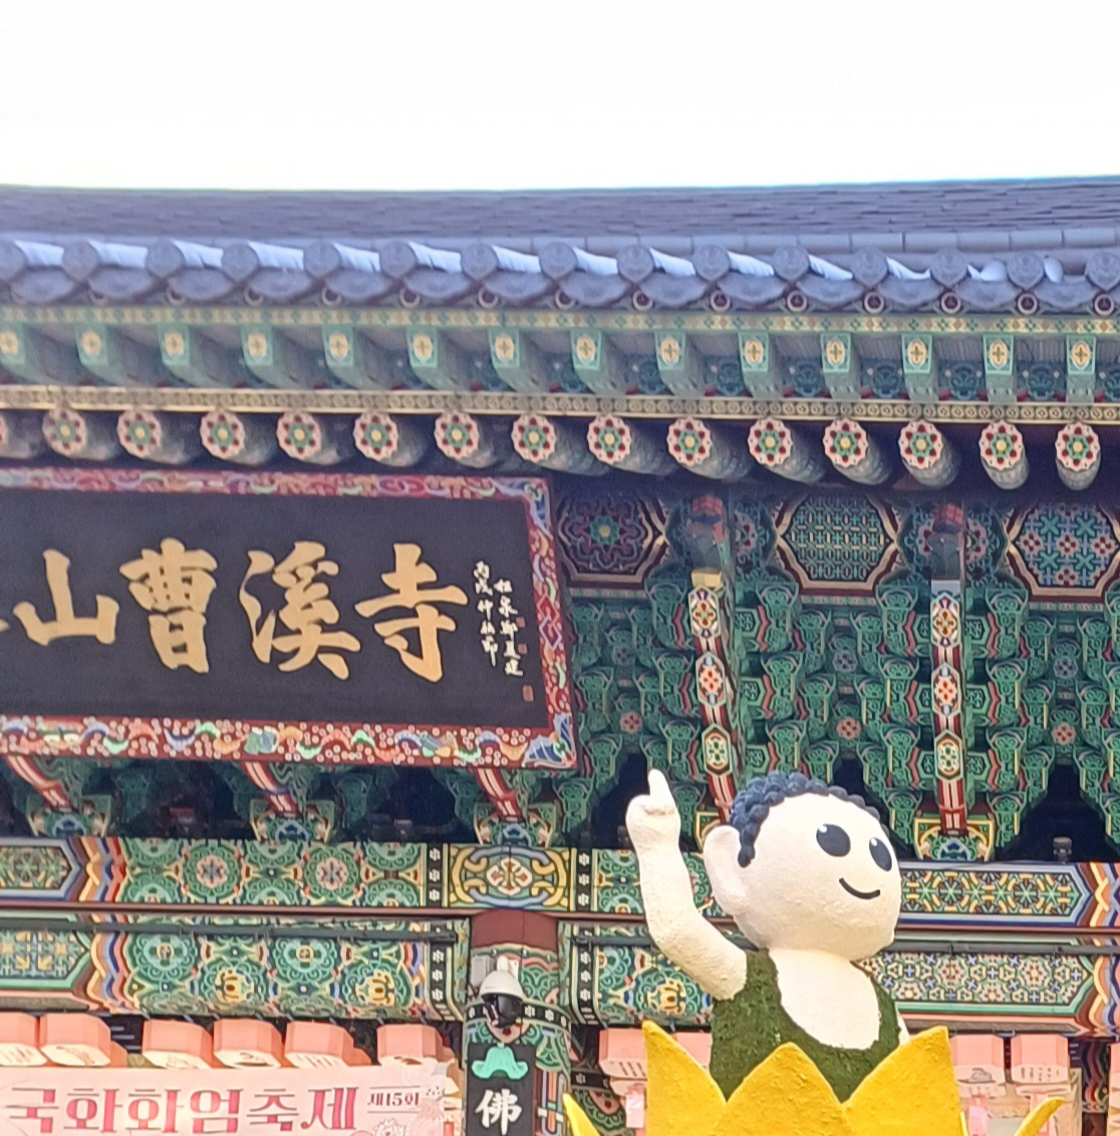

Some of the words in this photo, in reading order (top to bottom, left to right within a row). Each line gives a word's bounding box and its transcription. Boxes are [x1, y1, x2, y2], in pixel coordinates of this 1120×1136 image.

[0, 537, 469, 682] 山曹溪寺
[367, 1091, 420, 1107] 제15회
